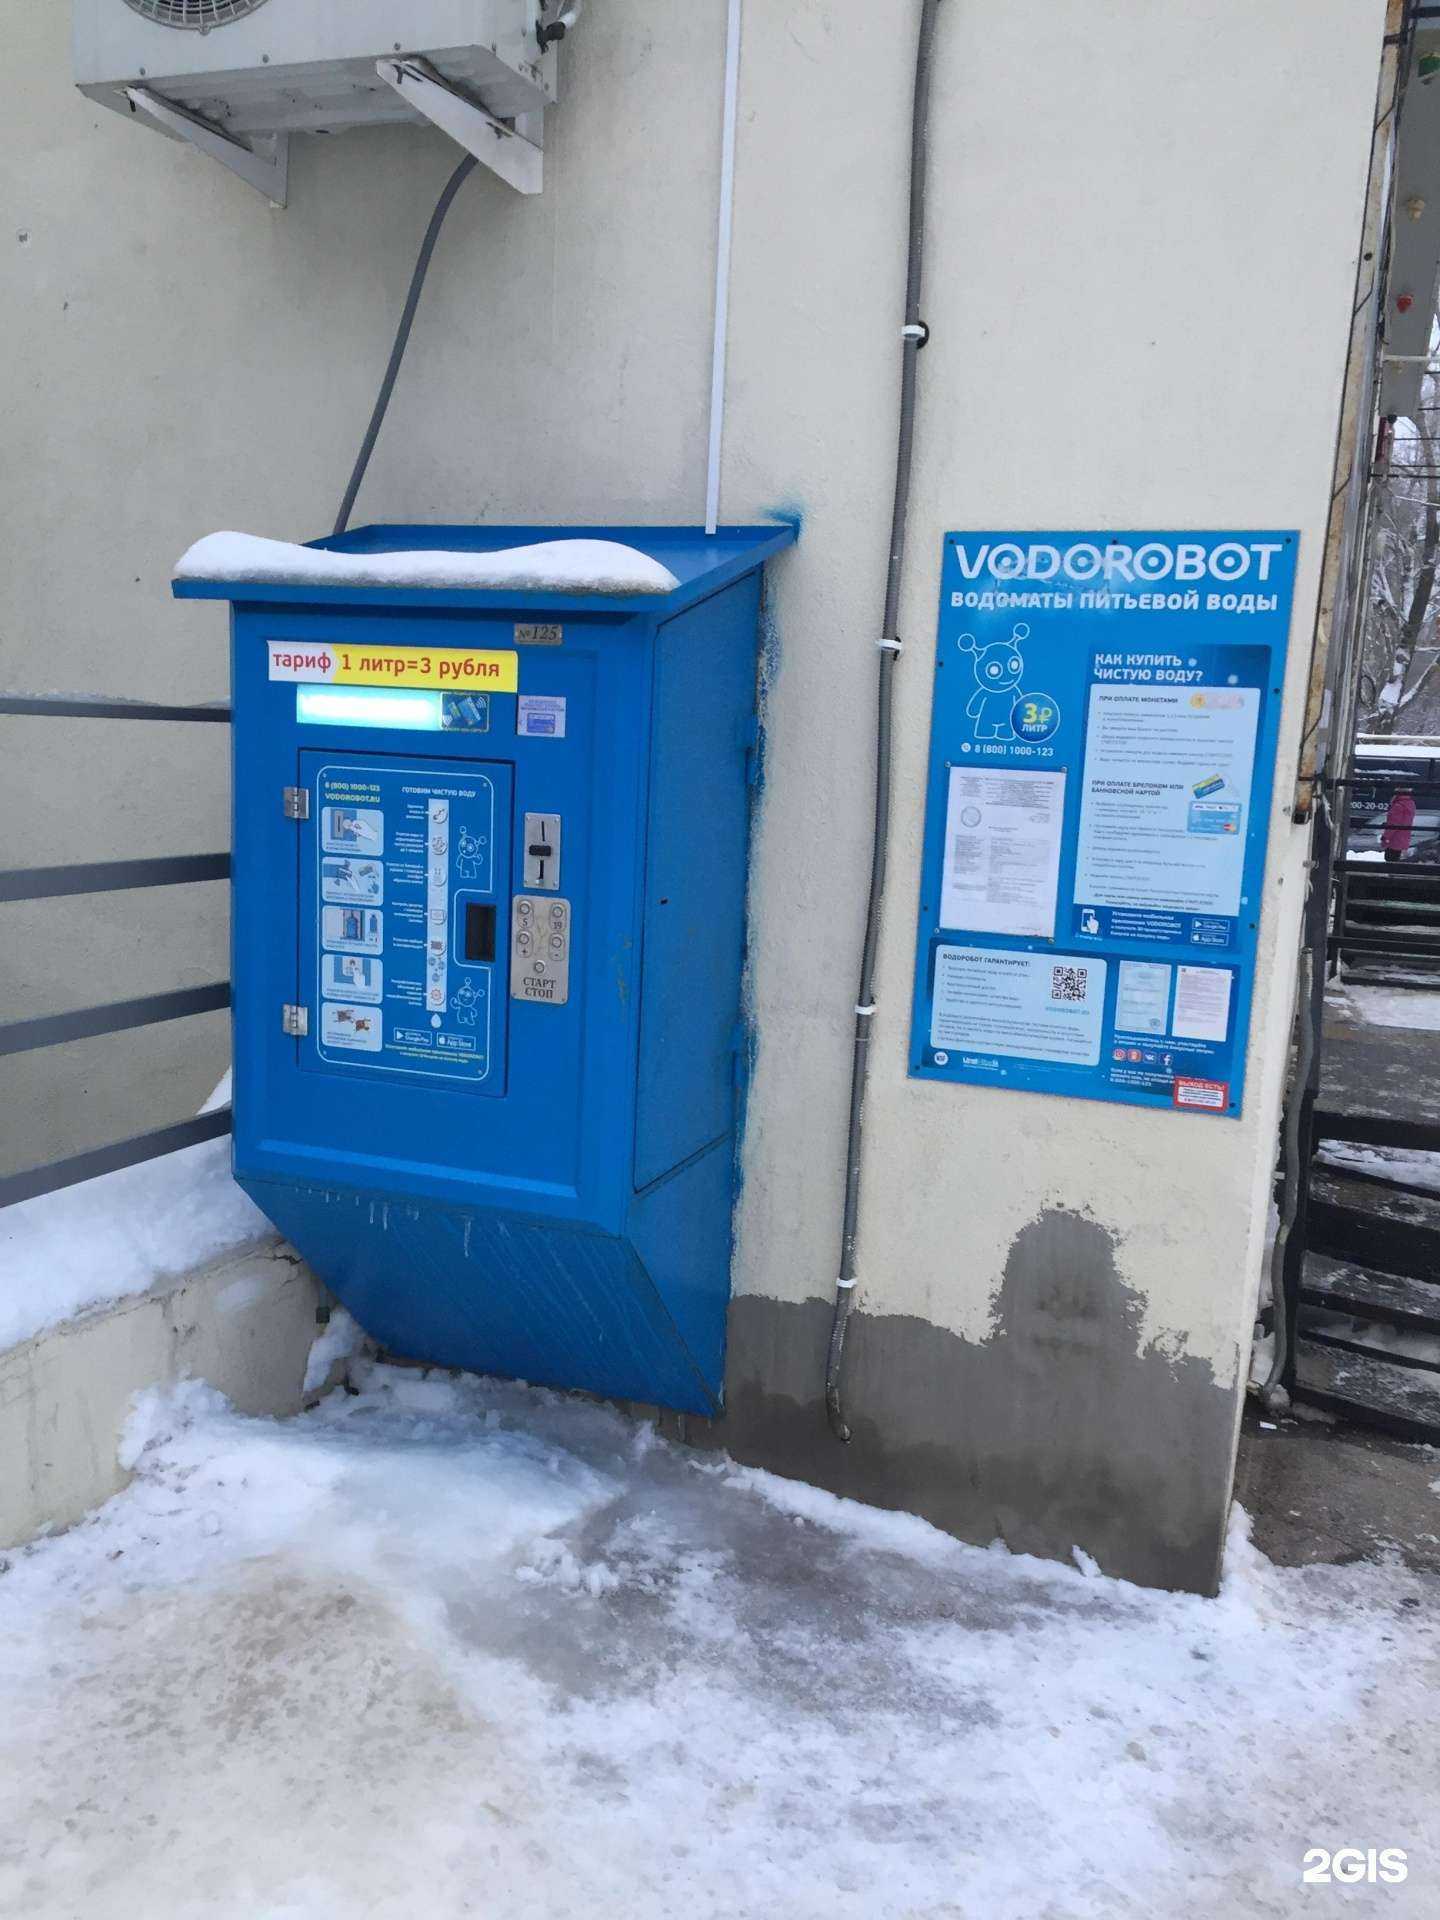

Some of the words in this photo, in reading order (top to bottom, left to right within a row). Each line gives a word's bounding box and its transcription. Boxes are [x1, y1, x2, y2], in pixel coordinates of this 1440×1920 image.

[955, 542, 1283, 581] VODOROBOT
[951, 590, 1073, 610] ВОДОМАТЫ
[1079, 589, 1200, 612] ПИТЬЕВОЙ
[1206, 592, 1278, 614] ВОДЫ
[272, 652, 332, 674] тариф
[341, 654, 352, 672] 1
[360, 656, 432, 677] литр=3
[439, 657, 500, 680] рубля
[1095, 653, 1122, 666] КАК
[1126, 654, 1183, 667] КУПИТЬ
[1094, 668, 1152, 681] ЧИСТУЮ
[1155, 669, 1204, 683] ВОДУ?
[1021, 724, 1048, 733] ЛИТР
[1010, 745, 1054, 758] 1000-123
[1350, 801, 1389, 811] 00-20-02
[942, 953, 983, 964] ВОДОРОБОТ
[522, 976, 556, 989] СТАРТ
[524, 986, 554, 999] СТОП
